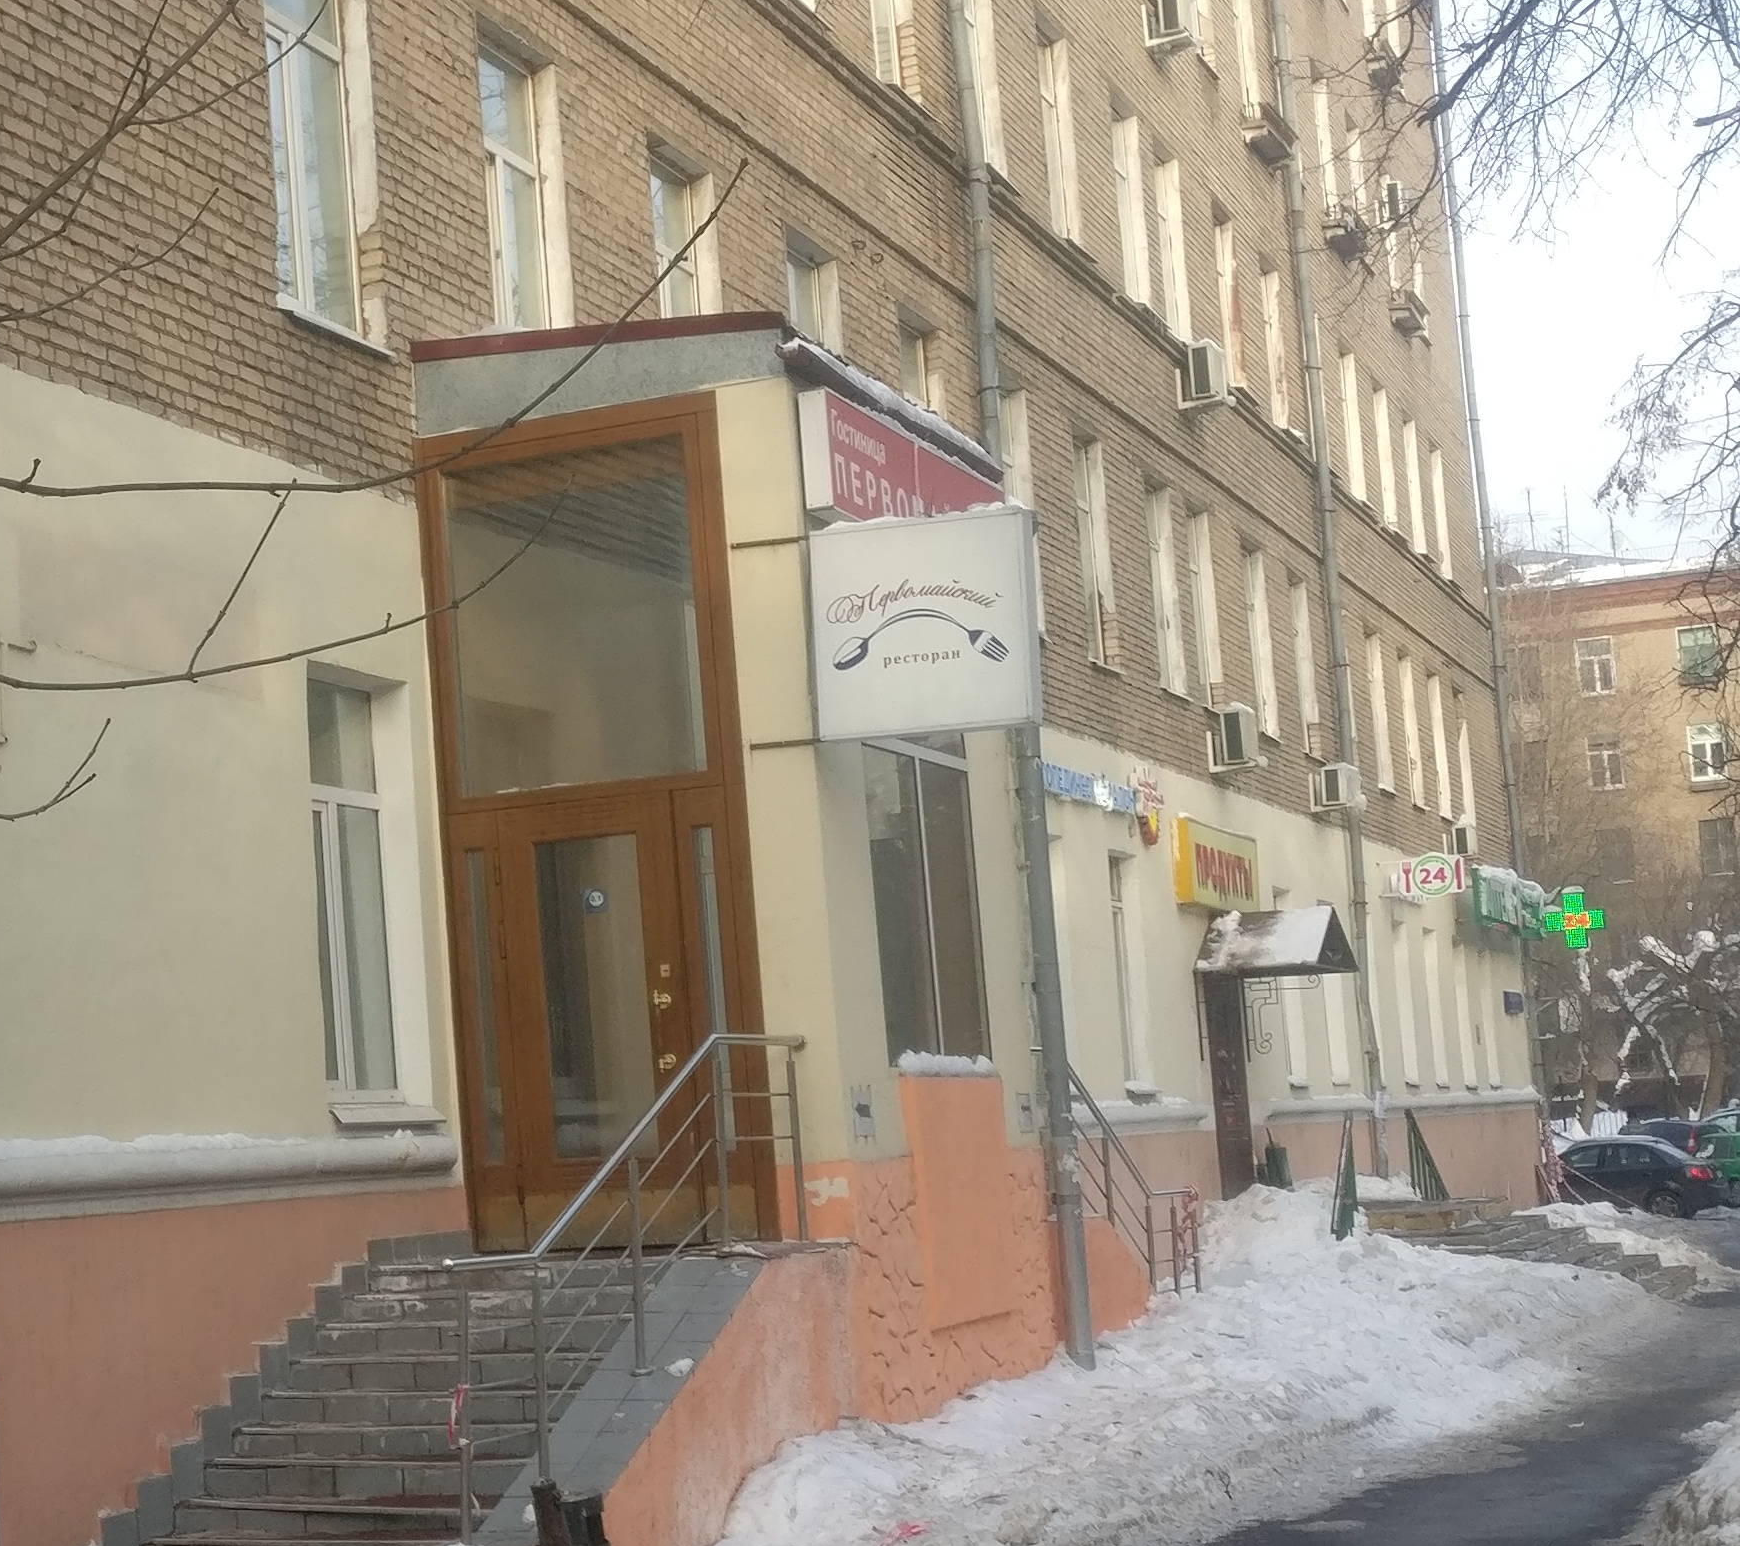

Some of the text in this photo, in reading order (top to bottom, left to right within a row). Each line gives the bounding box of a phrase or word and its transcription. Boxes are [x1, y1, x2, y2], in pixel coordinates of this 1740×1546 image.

[830, 408, 887, 467] Гостиница
[826, 578, 1004, 624] Первомайский
[882, 649, 961, 669] ресторан
[1419, 866, 1448, 885] 24
